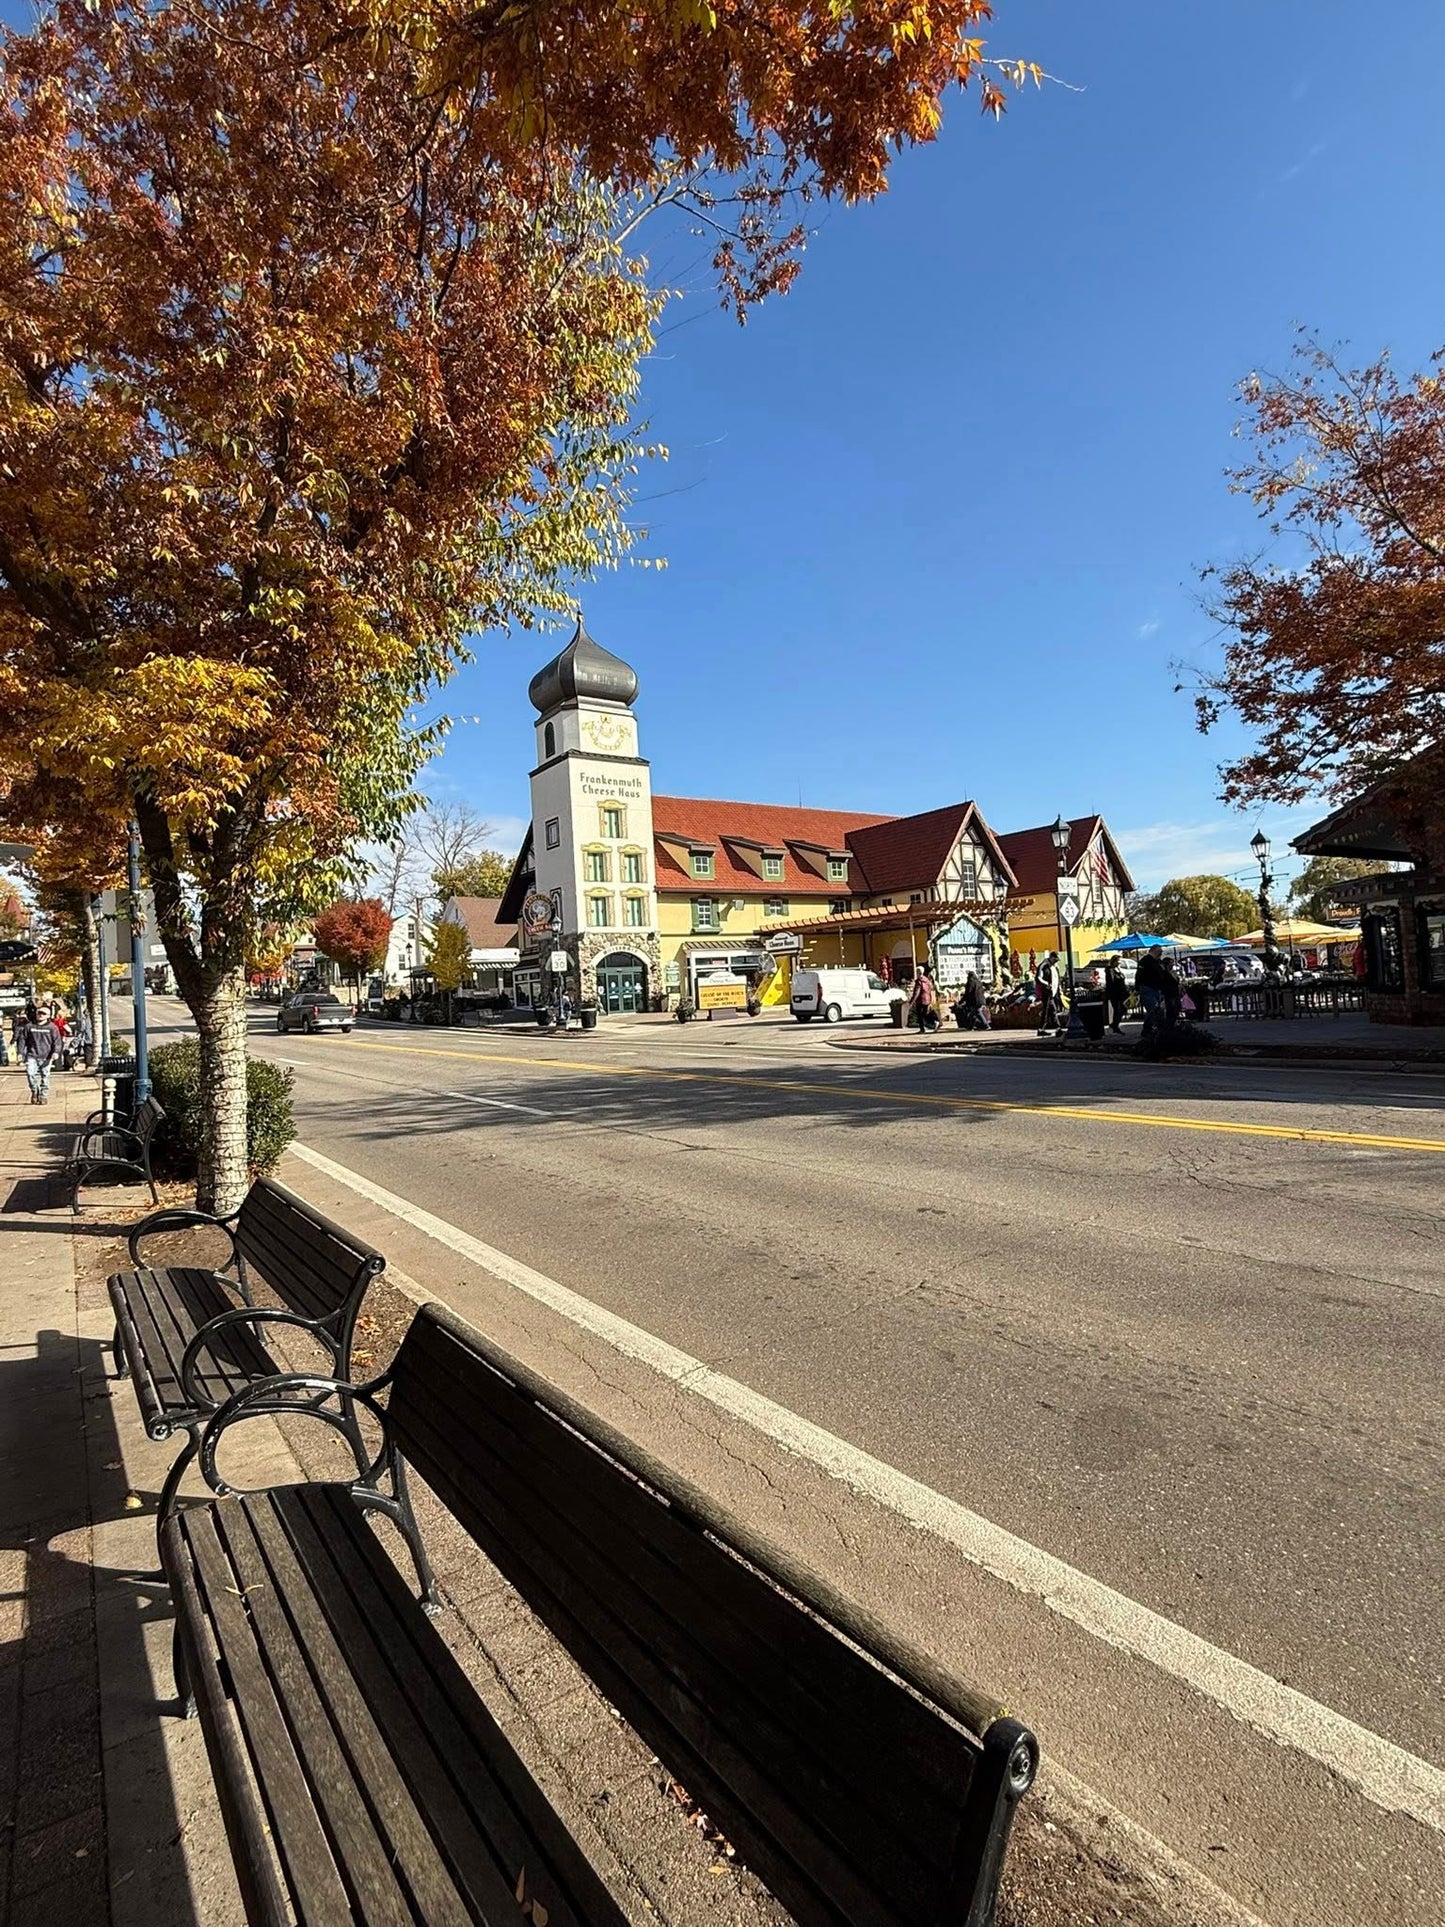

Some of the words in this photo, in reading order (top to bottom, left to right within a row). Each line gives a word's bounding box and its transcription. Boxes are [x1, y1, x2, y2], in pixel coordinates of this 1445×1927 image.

[579, 772, 642, 788] Frankenmuth
[582, 784, 615, 796] Cheese
[618, 787, 640, 799] Haus
[1065, 906, 1074, 918] 83
[554, 961, 566, 969] 30
